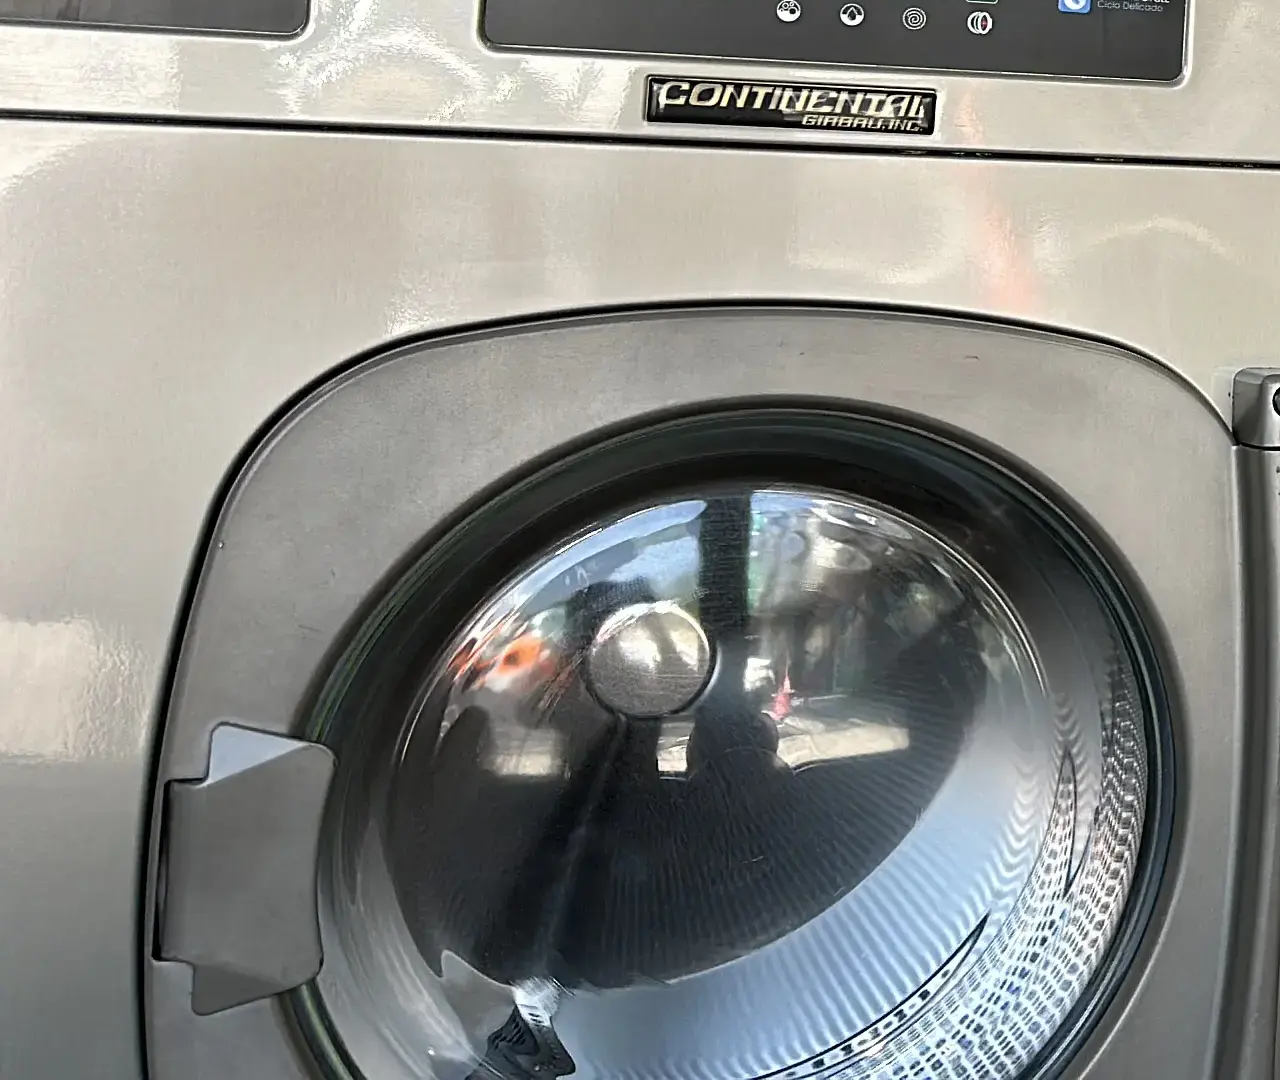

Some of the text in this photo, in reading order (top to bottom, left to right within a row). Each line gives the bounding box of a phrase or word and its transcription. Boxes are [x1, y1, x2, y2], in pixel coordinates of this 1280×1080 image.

[1098, 0, 1163, 12] Ciclo Delicado
[658, 80, 924, 118] CONTINENTAL
